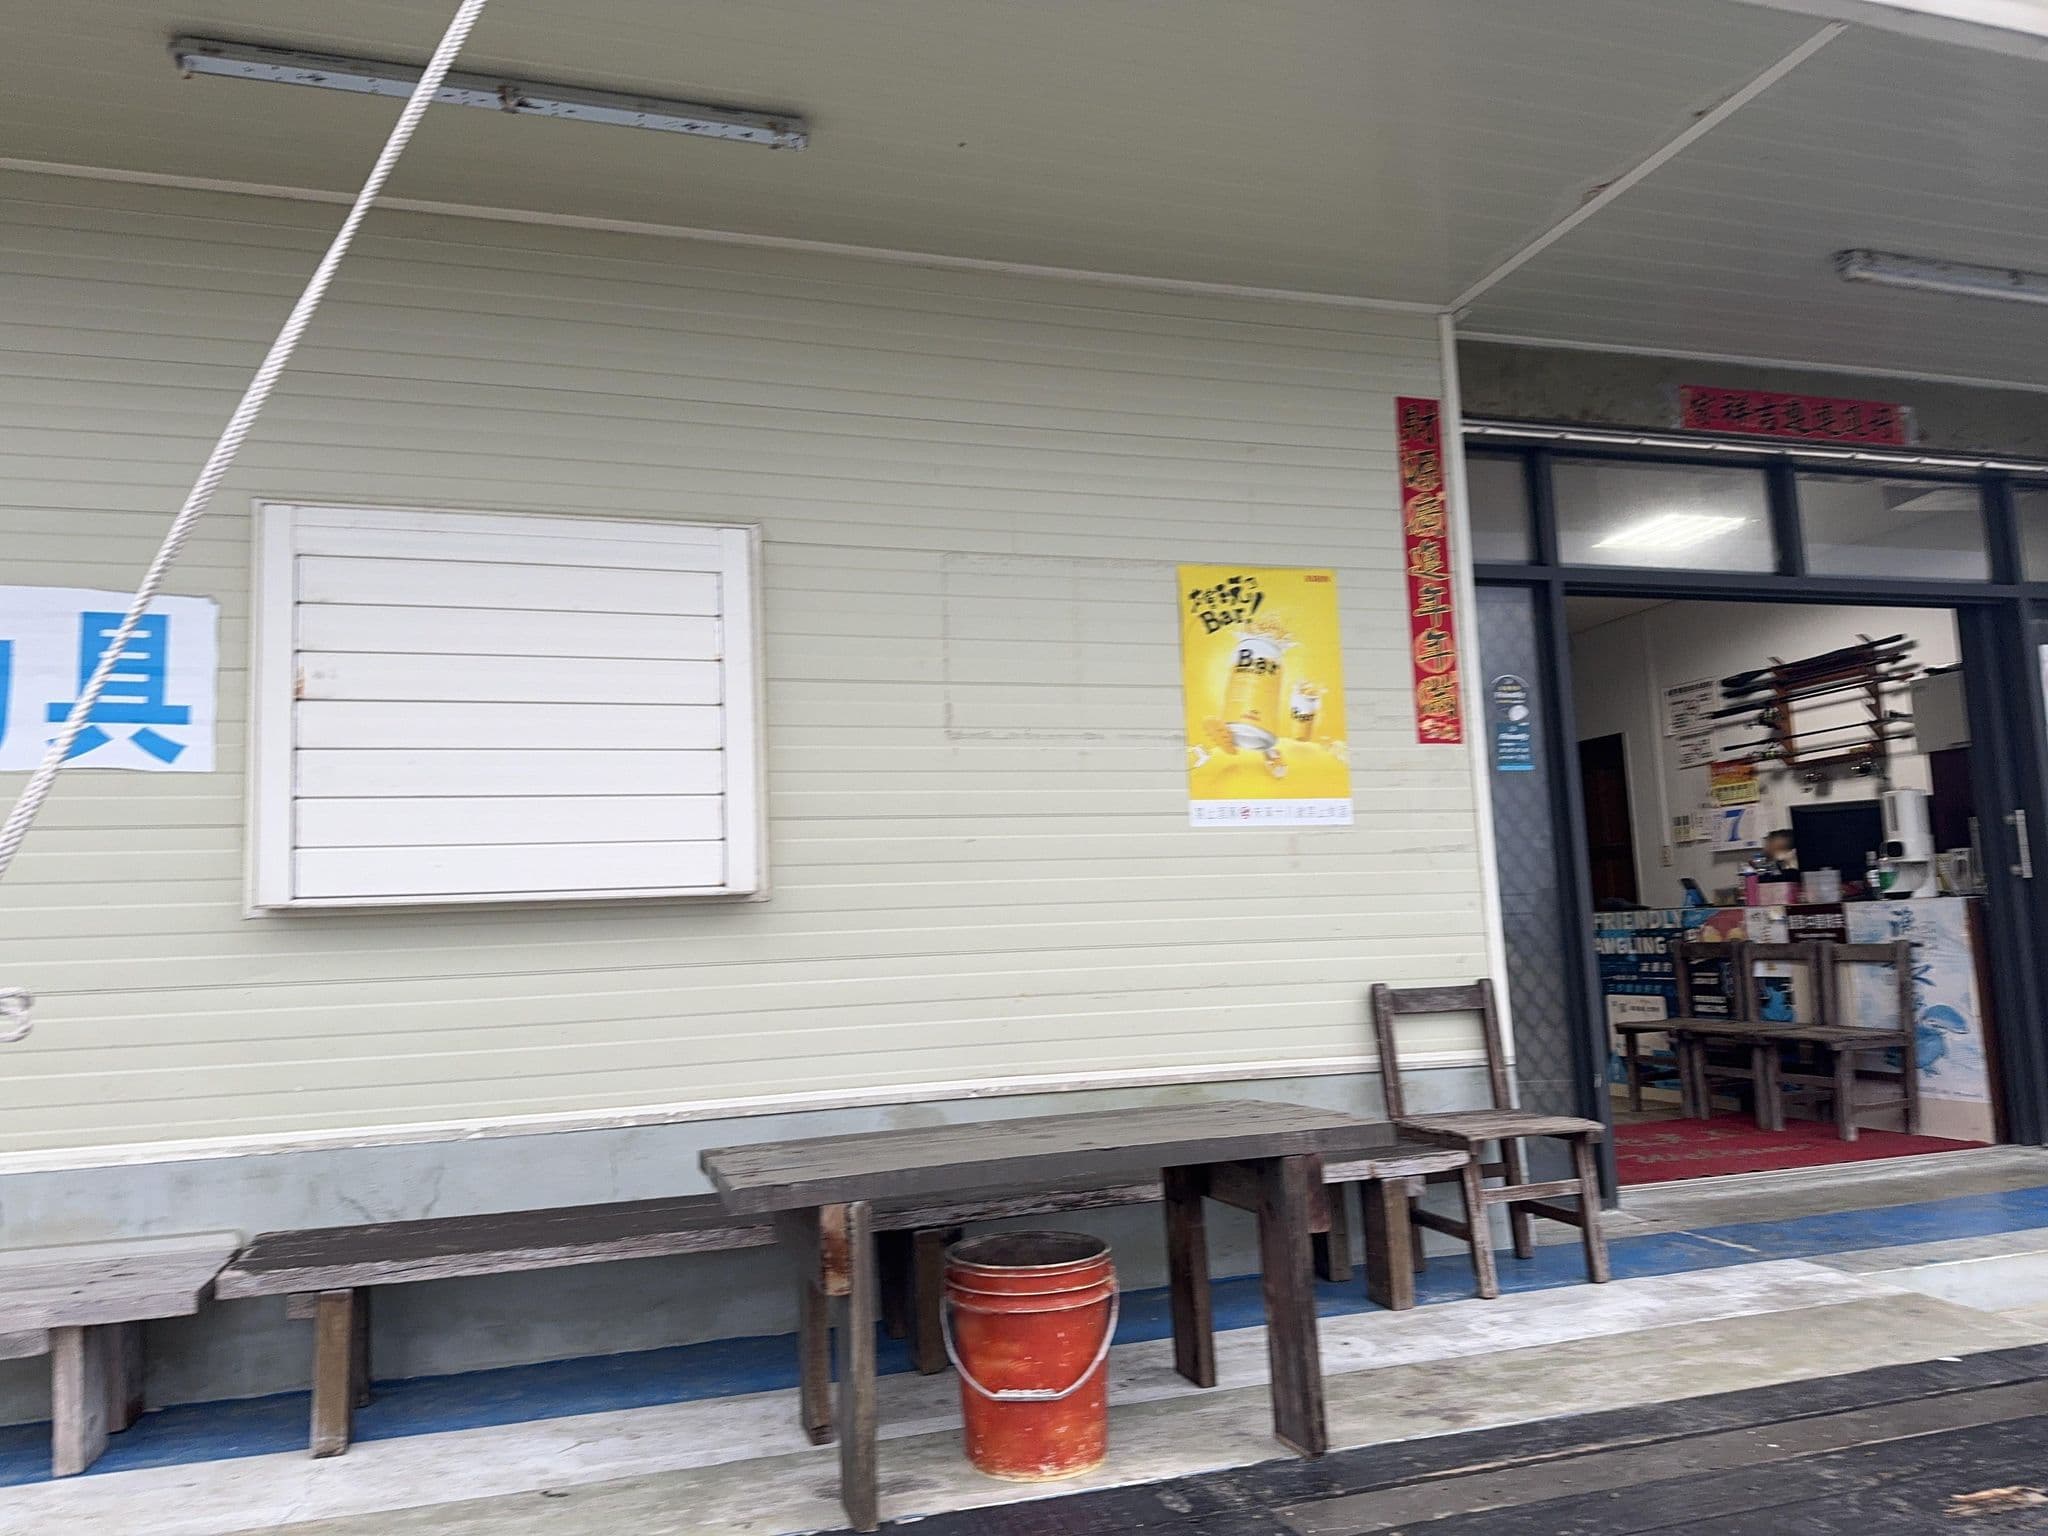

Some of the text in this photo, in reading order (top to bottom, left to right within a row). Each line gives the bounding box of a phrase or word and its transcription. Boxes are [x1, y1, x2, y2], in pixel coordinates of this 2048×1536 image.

[0, 611, 191, 764] 具
[1723, 808, 1746, 842] 7
[1594, 910, 1683, 930] FRIENDLY
